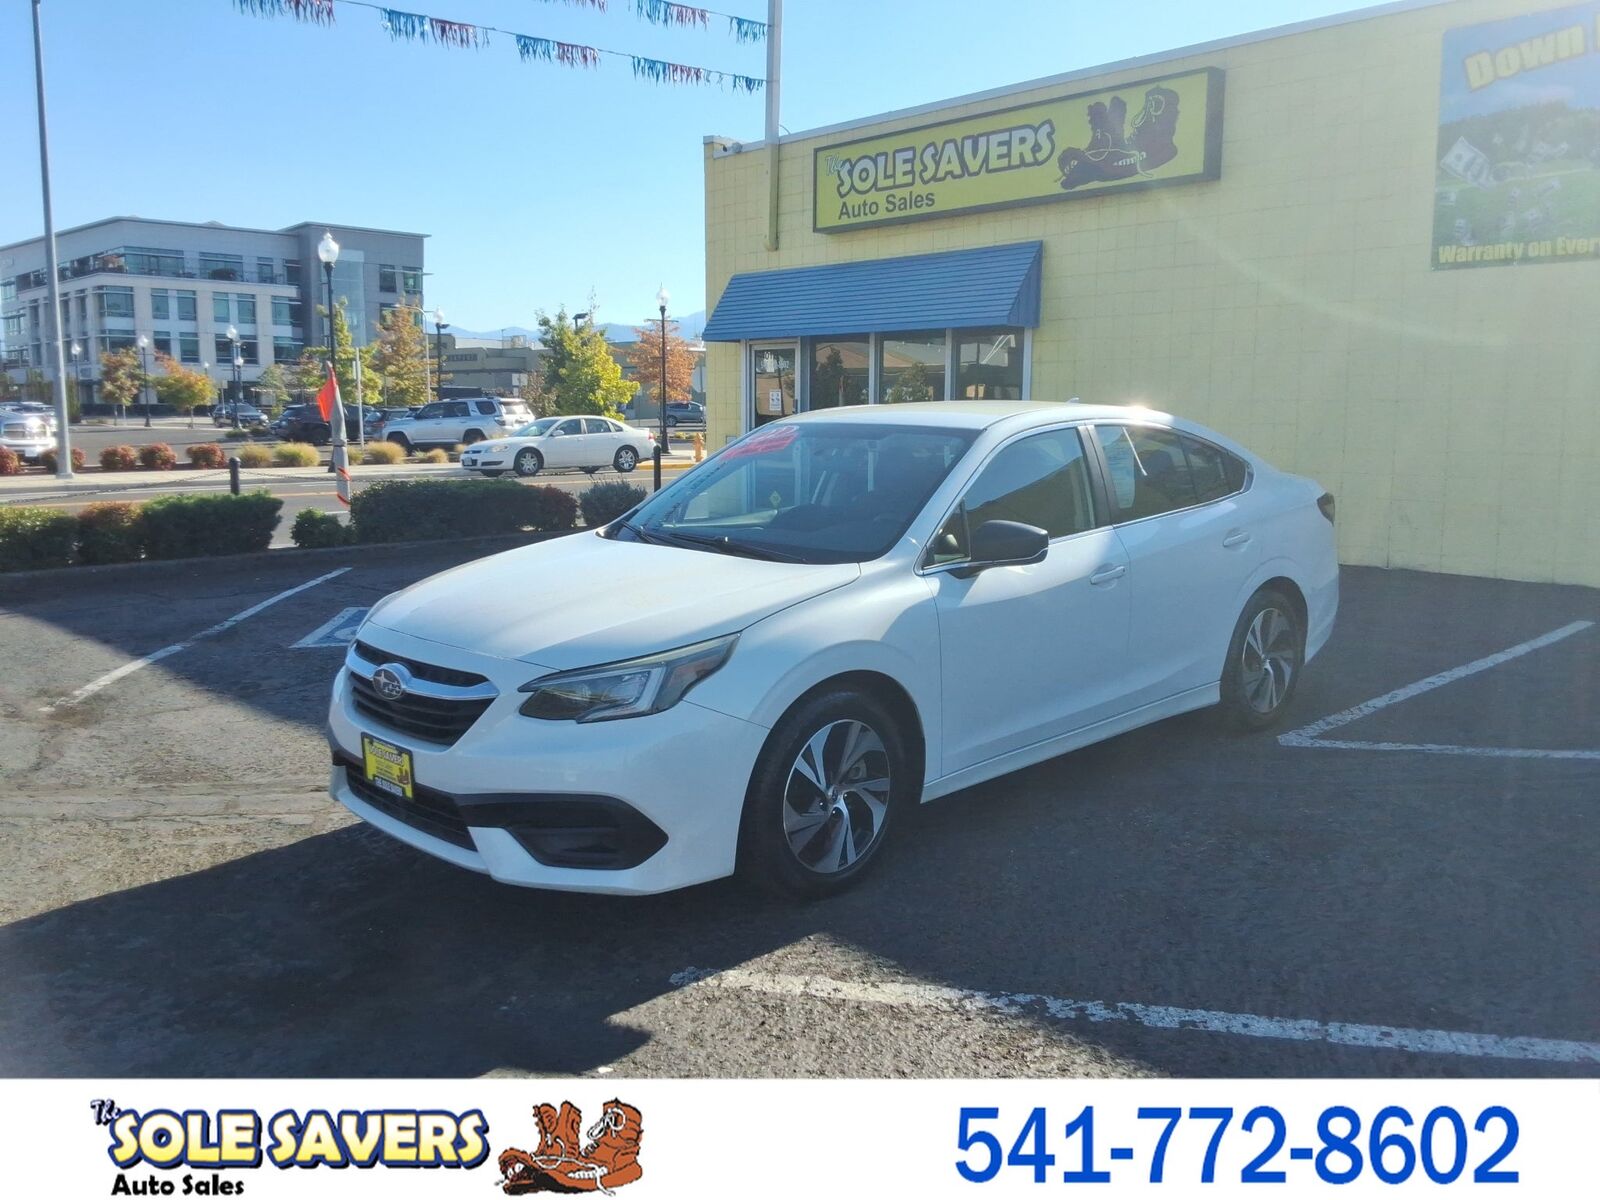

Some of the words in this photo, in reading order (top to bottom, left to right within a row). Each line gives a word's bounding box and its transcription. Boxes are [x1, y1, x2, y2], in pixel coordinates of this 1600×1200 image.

[836, 146, 915, 198] SOLE
[919, 118, 1056, 185] SAVERS
[838, 200, 879, 220] Auto
[885, 190, 935, 213] Sales
[1438, 240, 1524, 264] Warranty
[1528, 240, 1551, 258] on
